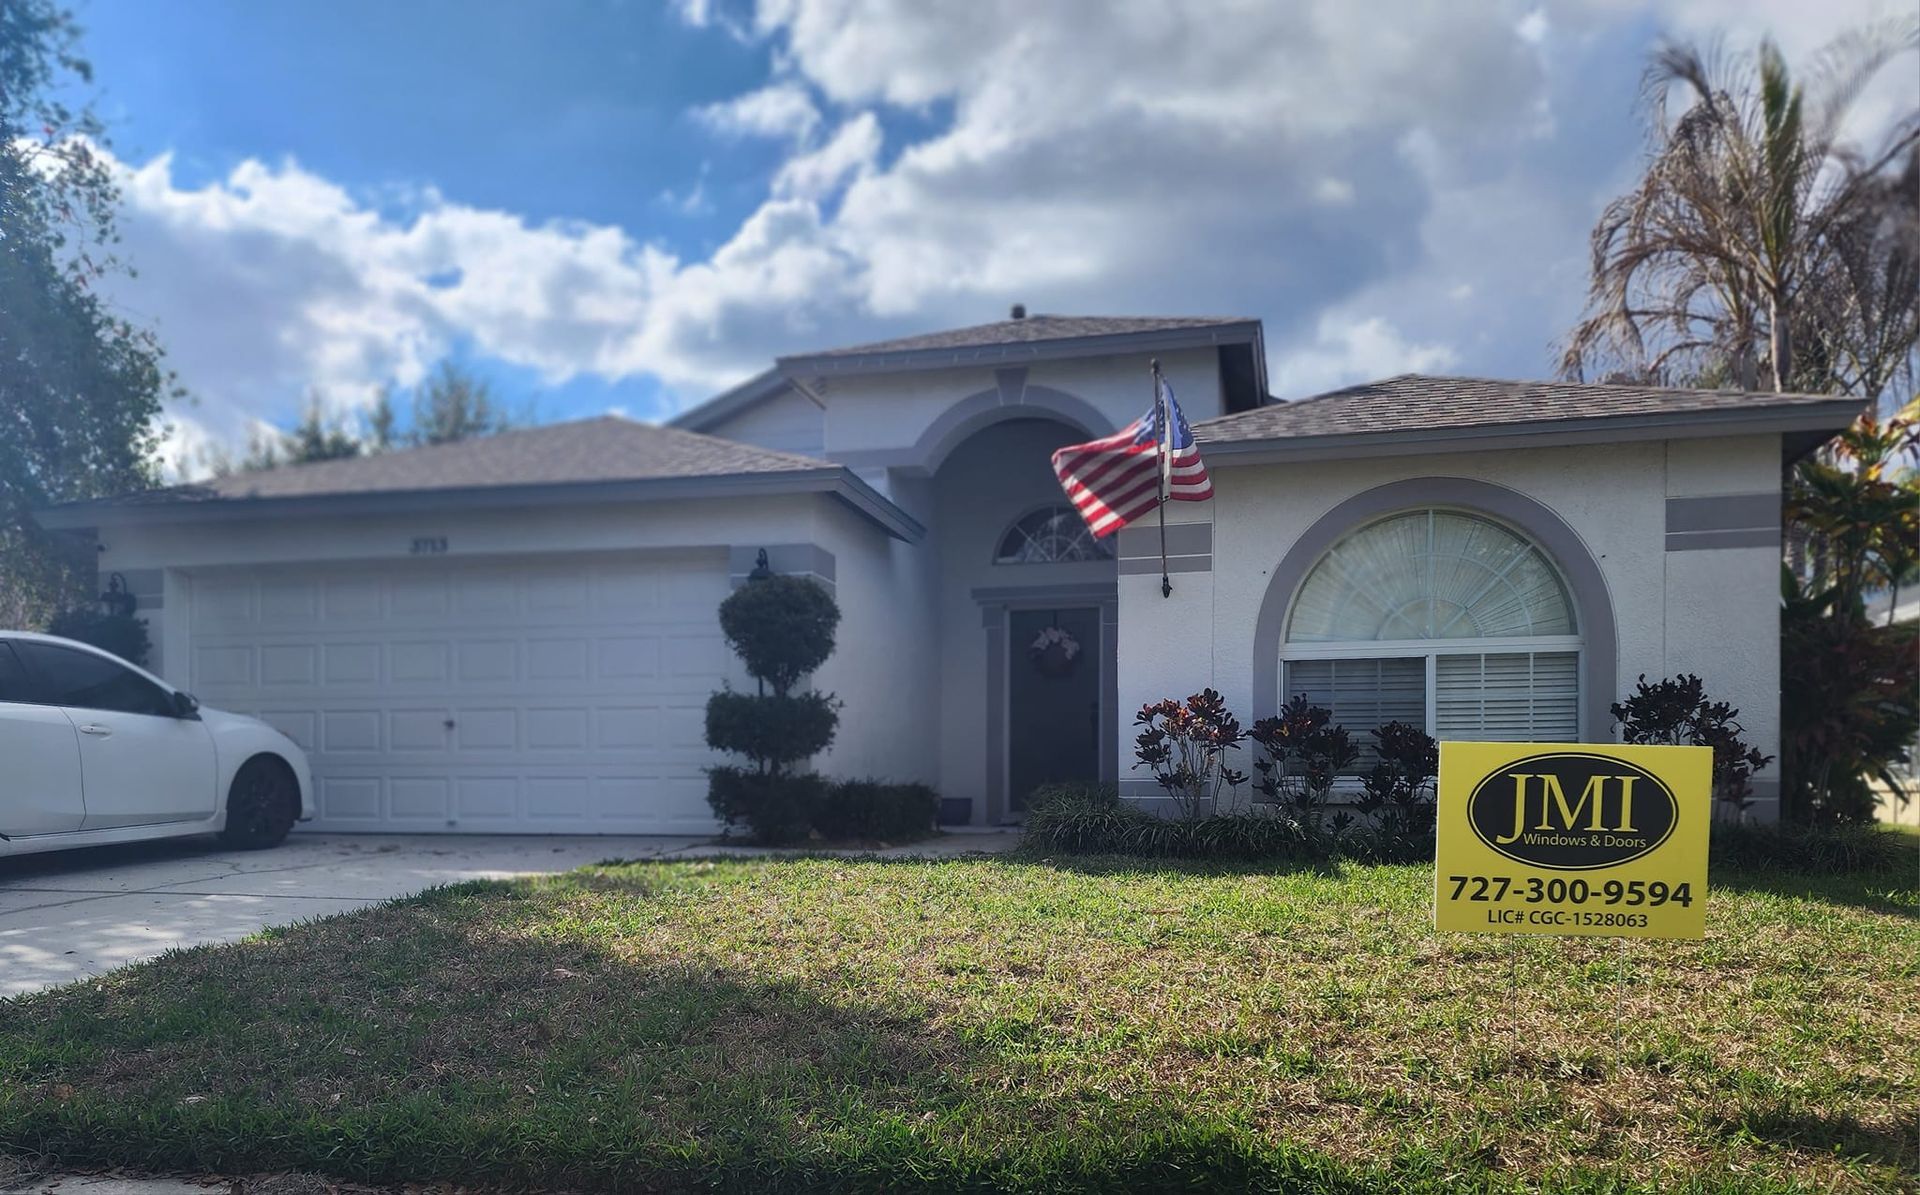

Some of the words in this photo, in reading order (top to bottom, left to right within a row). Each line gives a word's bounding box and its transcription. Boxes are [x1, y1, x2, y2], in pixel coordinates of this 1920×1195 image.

[1496, 773, 1641, 845] JMI
[1523, 833, 1587, 847] Windows
[1591, 835, 1601, 848] &
[1604, 835, 1647, 848] Doors
[1449, 876, 1693, 908] 727-300-9594
[1488, 909, 1525, 924] LIC#
[1530, 910, 1648, 928] CGC-1528063
